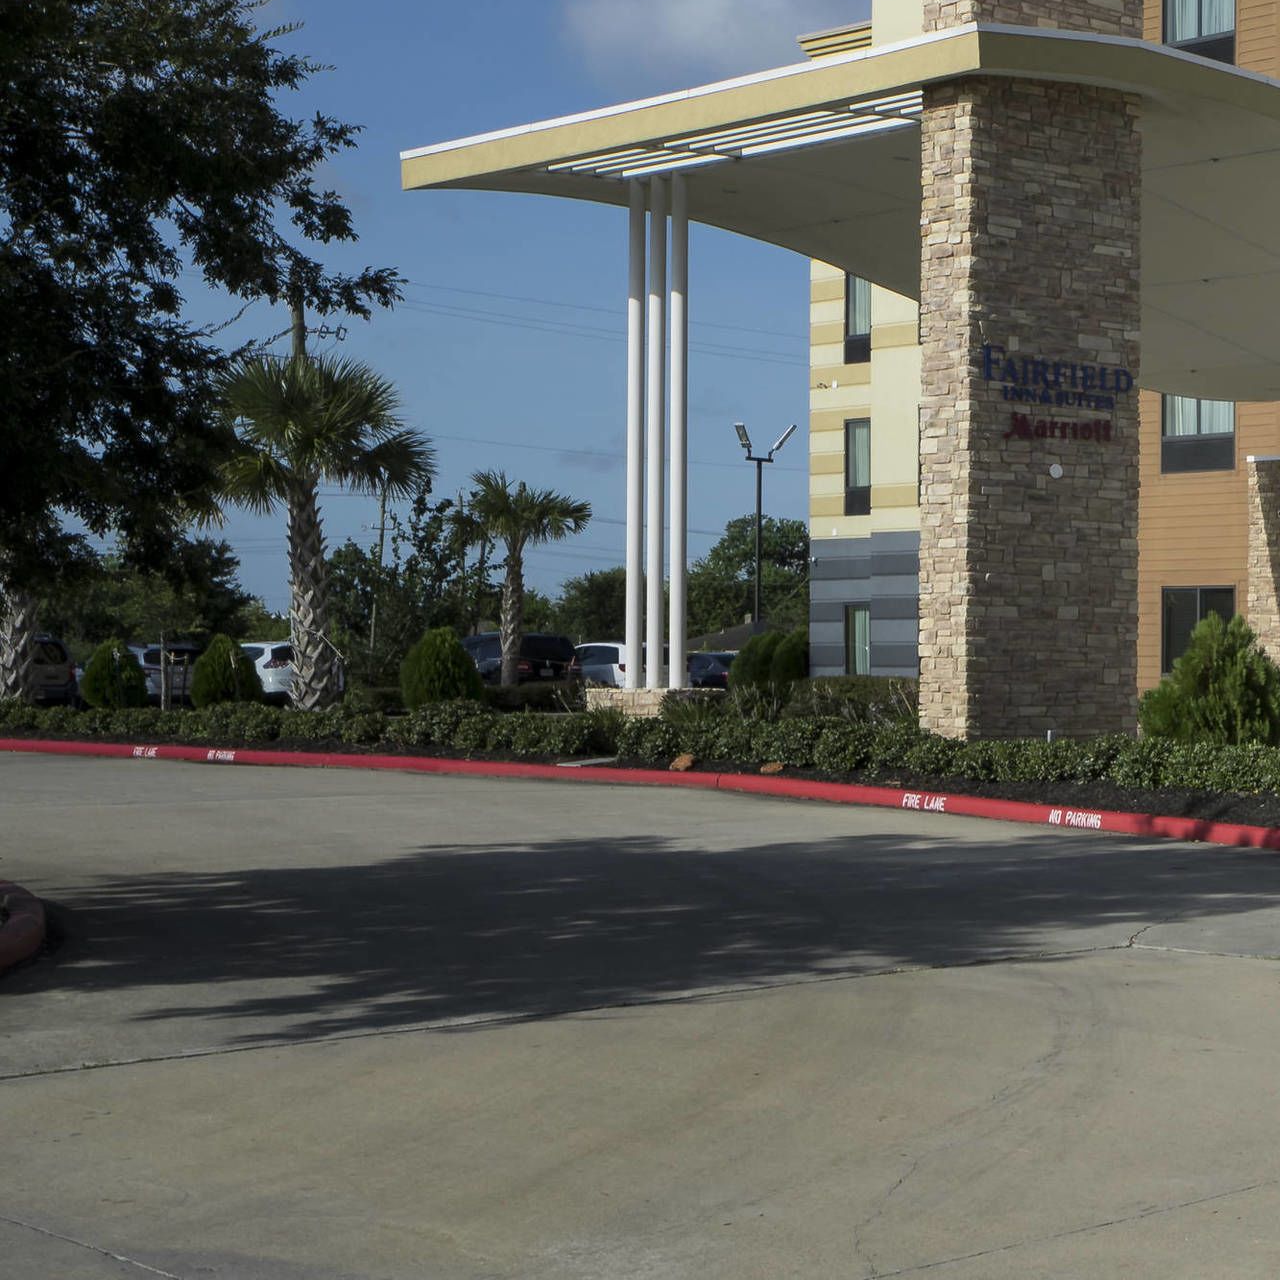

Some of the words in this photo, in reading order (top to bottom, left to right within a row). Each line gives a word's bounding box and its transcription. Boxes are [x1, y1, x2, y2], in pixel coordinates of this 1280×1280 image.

[982, 344, 1133, 393] FAIRFIELD
[1003, 385, 1037, 403] INN
[1055, 390, 1114, 410] SUITES
[1003, 411, 1112, 442] Marriott
[902, 793, 921, 809] FIRE
[924, 795, 947, 811] LANE
[1049, 809, 1061, 824] NO
[1064, 810, 1102, 829] PARKING
